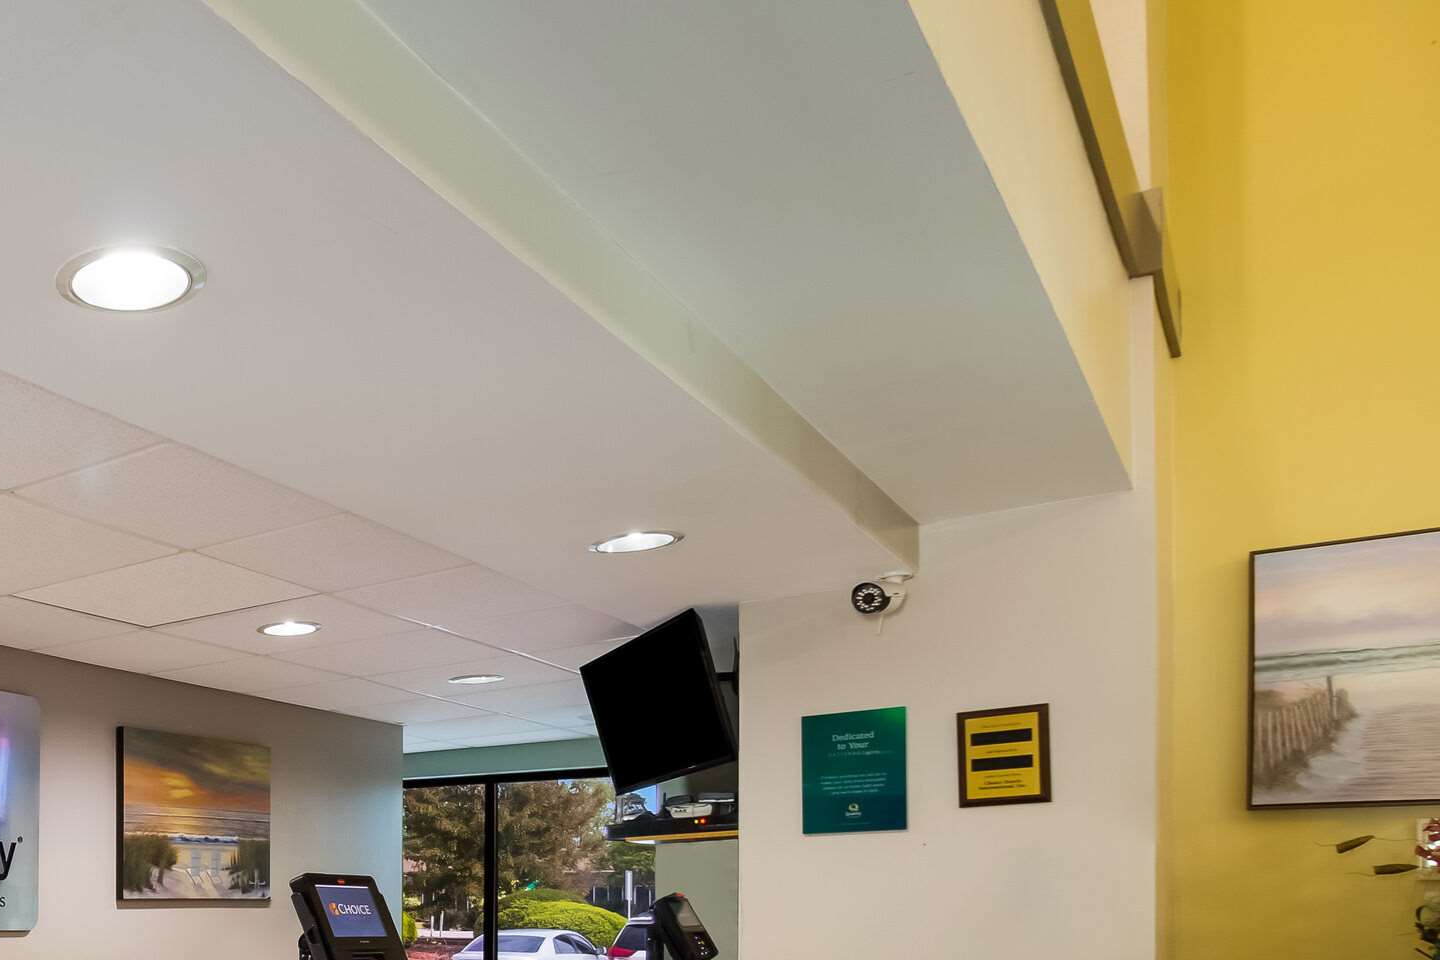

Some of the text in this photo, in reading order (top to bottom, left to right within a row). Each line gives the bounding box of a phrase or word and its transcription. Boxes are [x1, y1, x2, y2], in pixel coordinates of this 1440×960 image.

[831, 731, 875, 742] Dedicated
[837, 741, 870, 750] to Your
[338, 903, 372, 915] CHOICE
